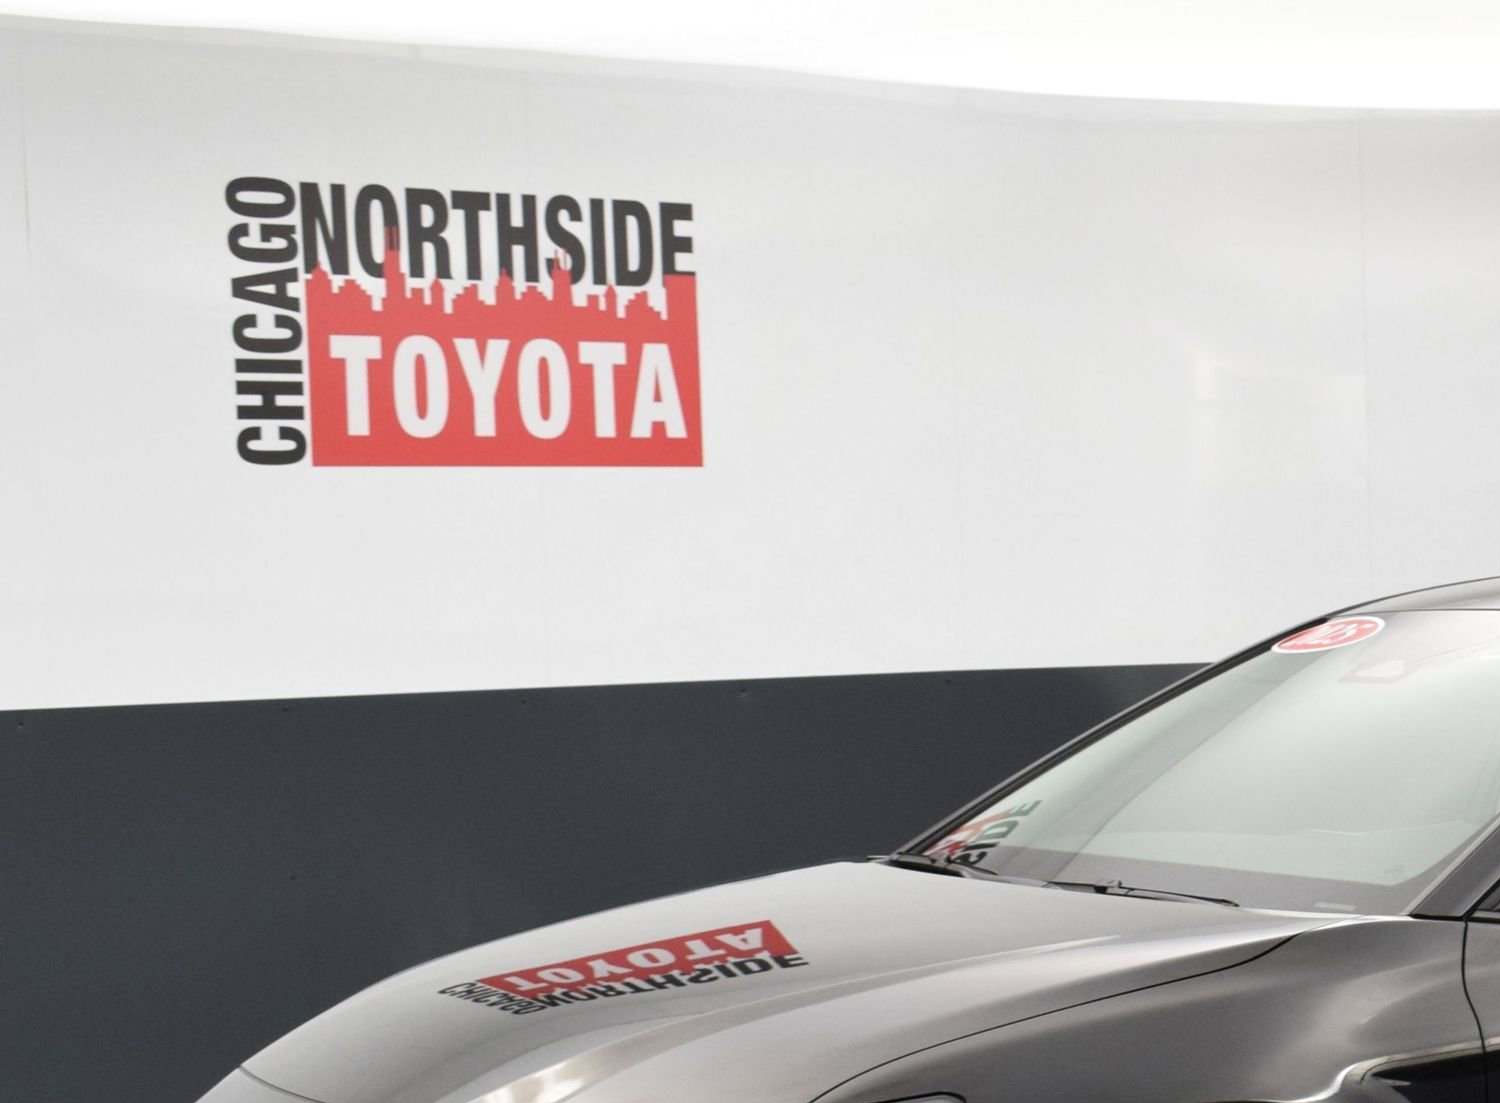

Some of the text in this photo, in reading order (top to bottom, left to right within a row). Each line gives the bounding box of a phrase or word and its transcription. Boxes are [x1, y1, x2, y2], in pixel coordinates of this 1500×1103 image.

[299, 181, 697, 288] NORTHSIDE
[225, 176, 306, 466] CHICAGO
[329, 334, 688, 440] TOYOTA
